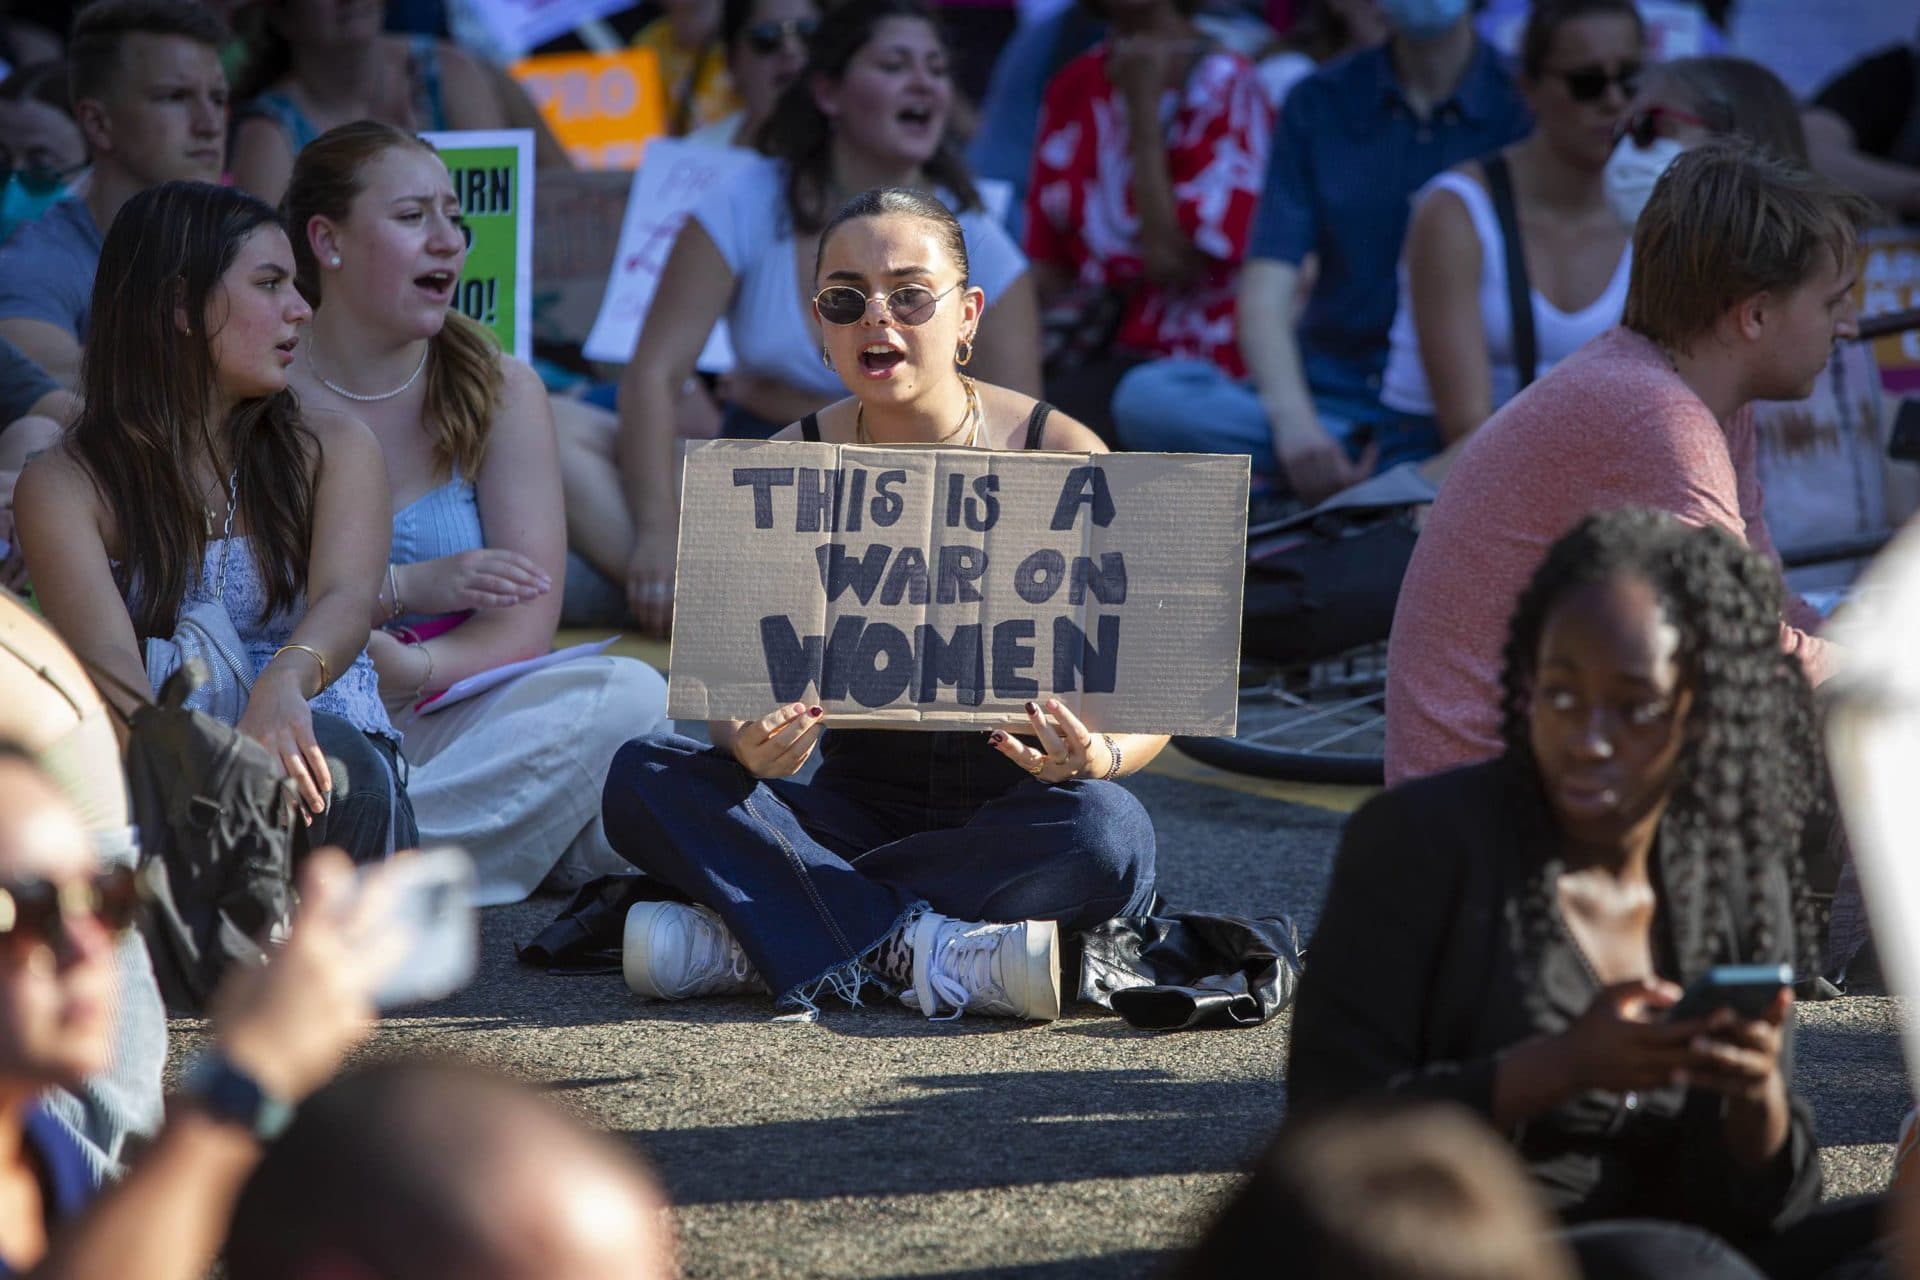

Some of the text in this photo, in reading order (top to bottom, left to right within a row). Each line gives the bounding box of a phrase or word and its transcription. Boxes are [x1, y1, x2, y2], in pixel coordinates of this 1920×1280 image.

[733, 466, 1116, 533] THIS IS A
[815, 544, 1127, 606] WAR ON
[759, 614, 1121, 709] WOMEN
